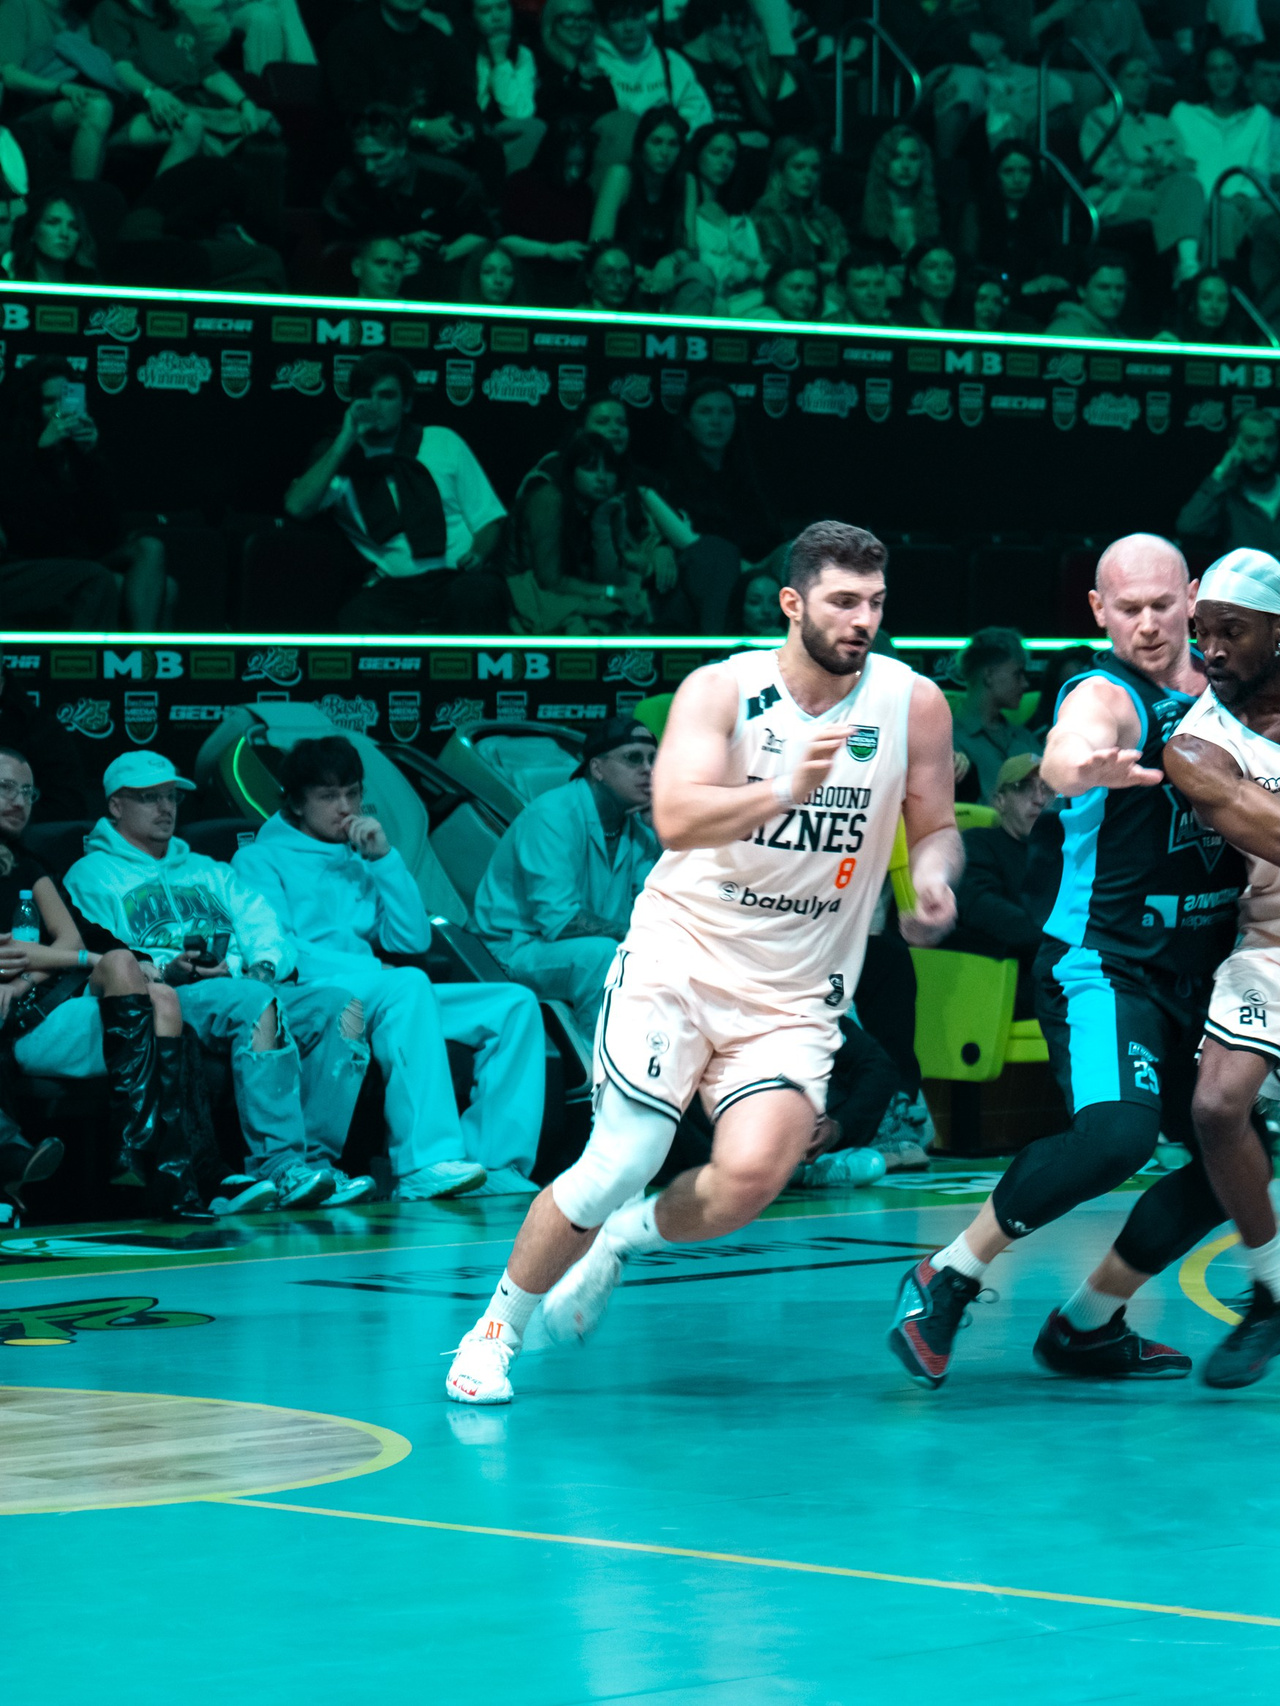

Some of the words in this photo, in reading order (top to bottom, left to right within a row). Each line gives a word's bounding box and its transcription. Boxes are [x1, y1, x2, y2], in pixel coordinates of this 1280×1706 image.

[834, 857, 857, 890] 8
[740, 886, 842, 920] babulya
[1239, 1006, 1267, 1028] 24
